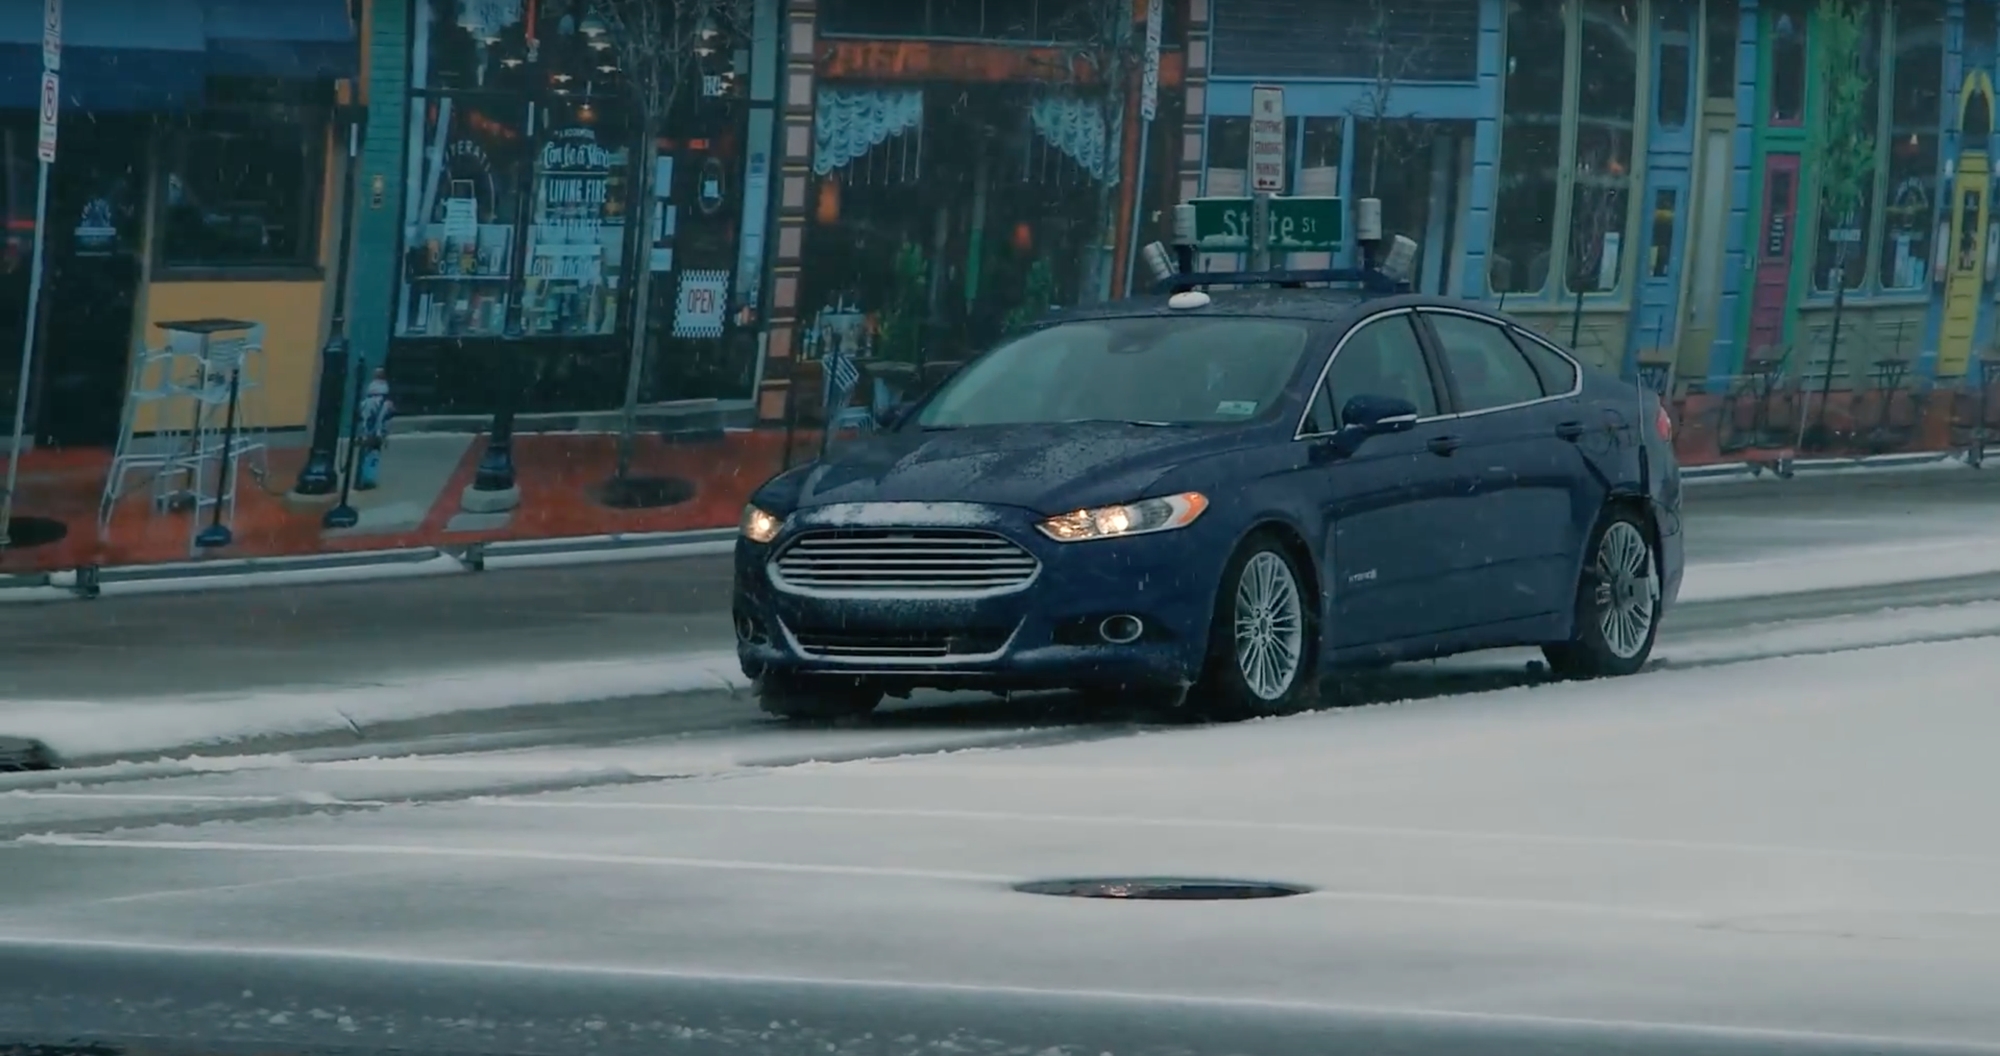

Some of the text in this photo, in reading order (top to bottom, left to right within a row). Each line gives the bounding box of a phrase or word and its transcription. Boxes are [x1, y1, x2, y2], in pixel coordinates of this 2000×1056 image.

[549, 178, 607, 203] LIVING FIRE
[1223, 209, 1316, 242] Stte St
[687, 288, 716, 314] OPEN
